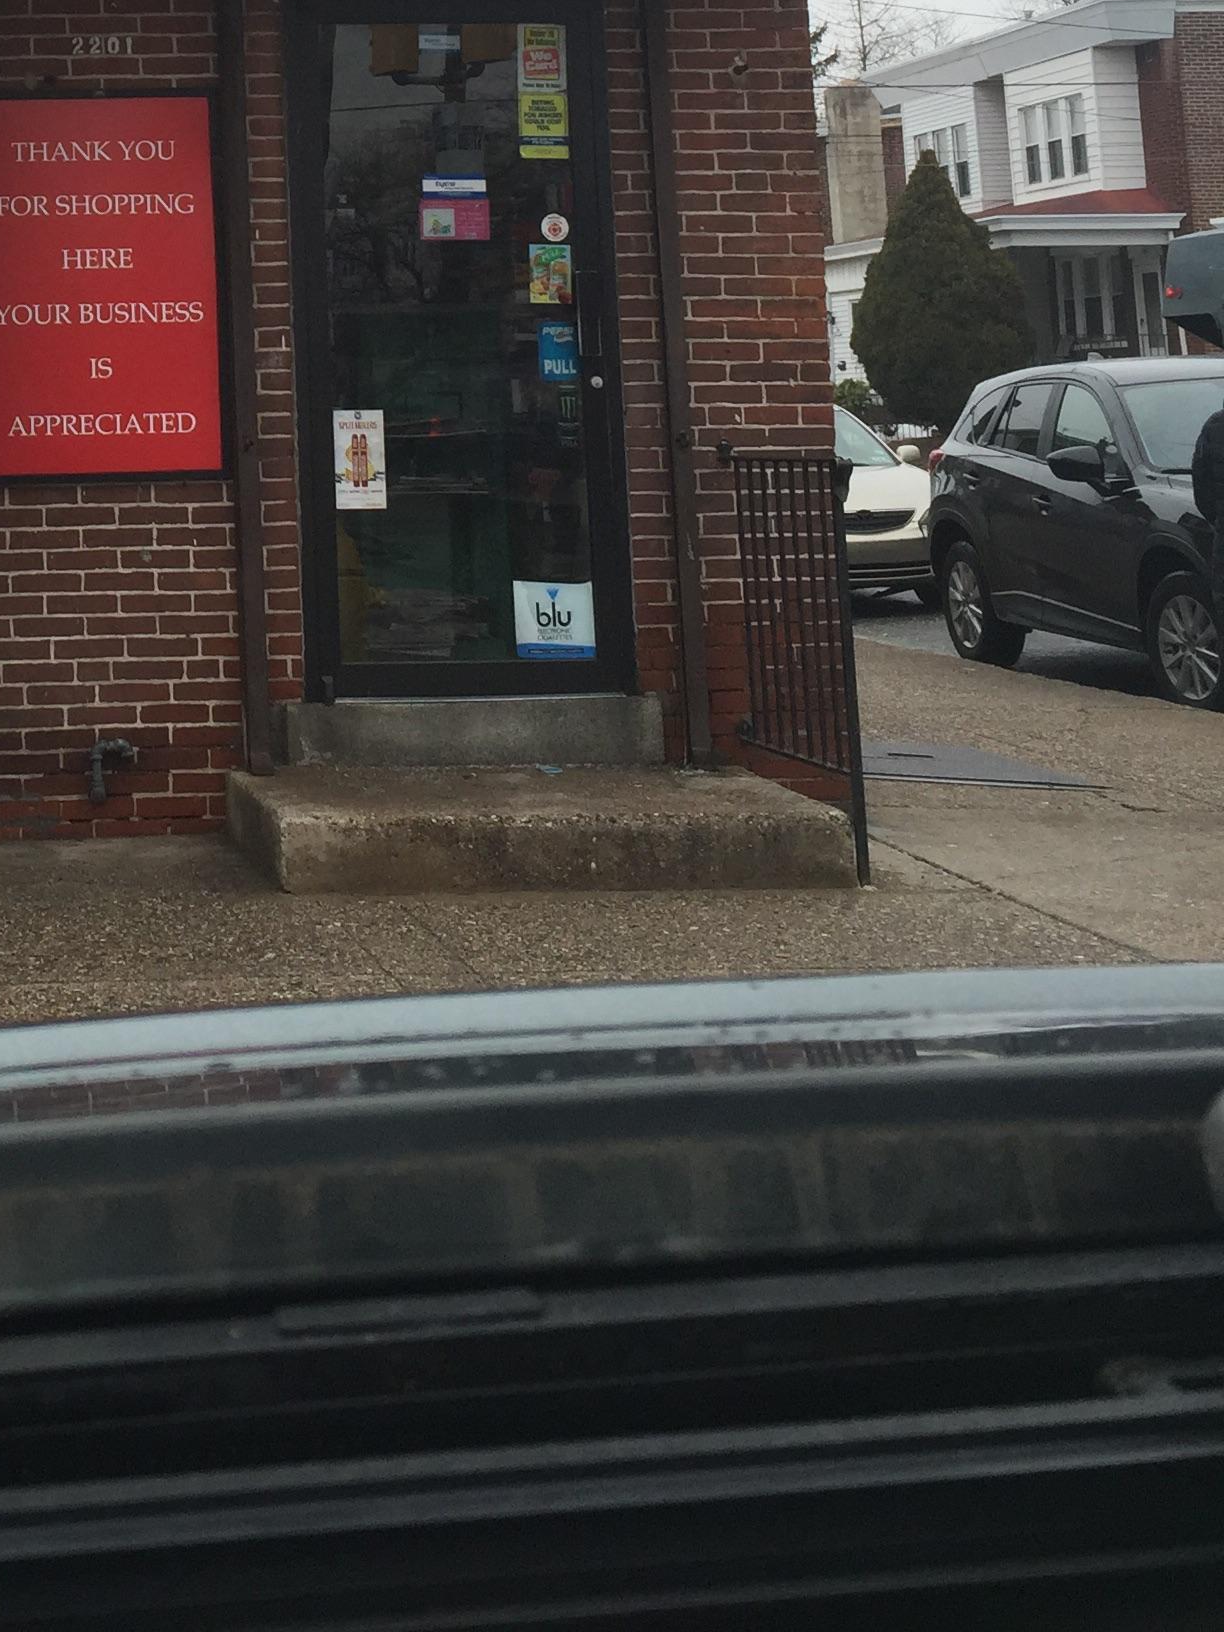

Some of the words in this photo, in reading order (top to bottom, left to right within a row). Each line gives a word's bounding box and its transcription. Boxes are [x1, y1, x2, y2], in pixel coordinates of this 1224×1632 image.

[72, 36, 134, 56] 2201
[11, 140, 112, 162] THANK
[118, 139, 175, 161] YOU
[56, 193, 195, 216] SHOPPING
[62, 248, 134, 270] HERE
[79, 302, 205, 325] BUSINESS
[89, 358, 113, 380] IS
[543, 359, 577, 375] PULL
[8, 412, 197, 437] APPRECIATED
[536, 601, 572, 627] blu
